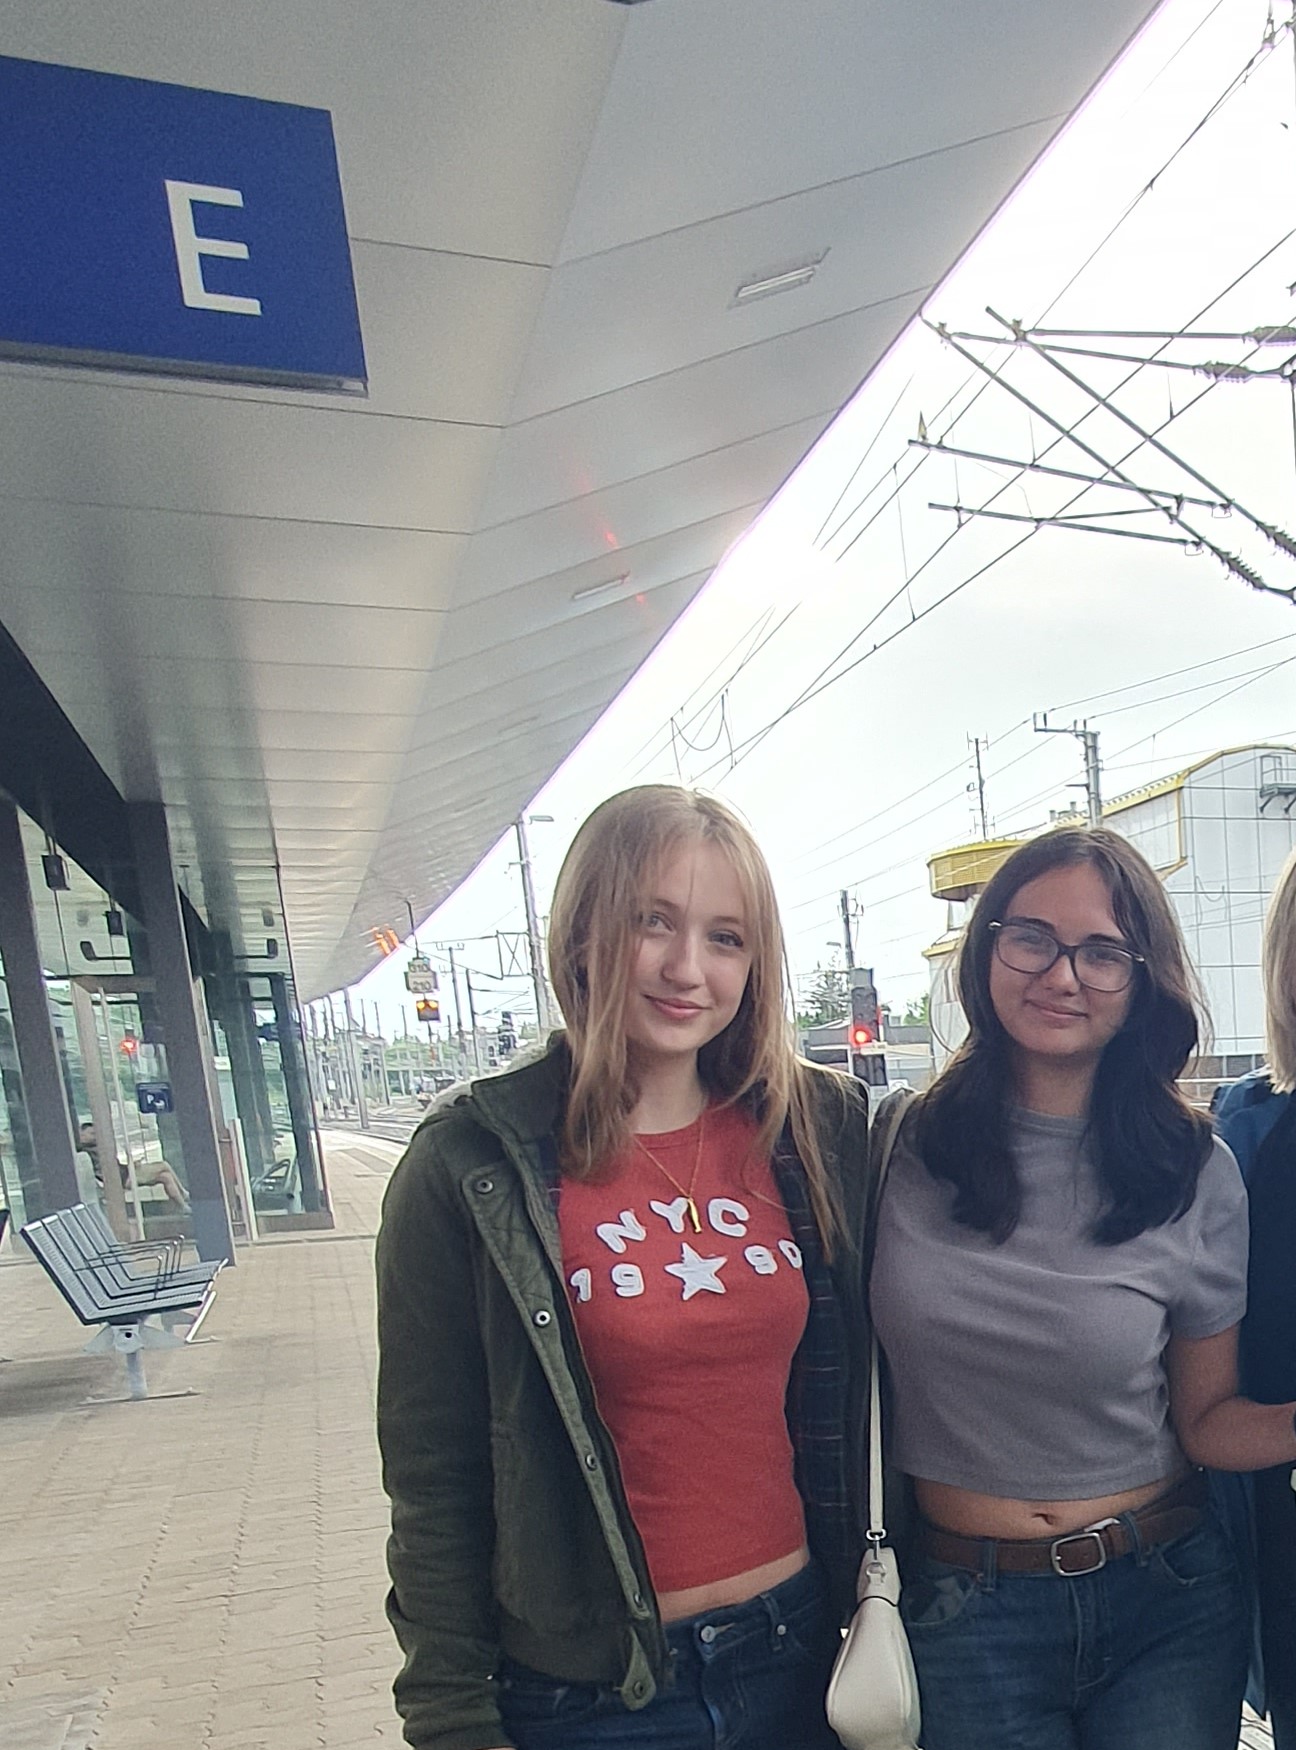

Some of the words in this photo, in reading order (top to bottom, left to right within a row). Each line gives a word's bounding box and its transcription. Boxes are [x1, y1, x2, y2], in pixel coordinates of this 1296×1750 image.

[164, 179, 263, 317] E
[596, 1196, 750, 1255] NYC
[569, 1262, 645, 1303] 19
